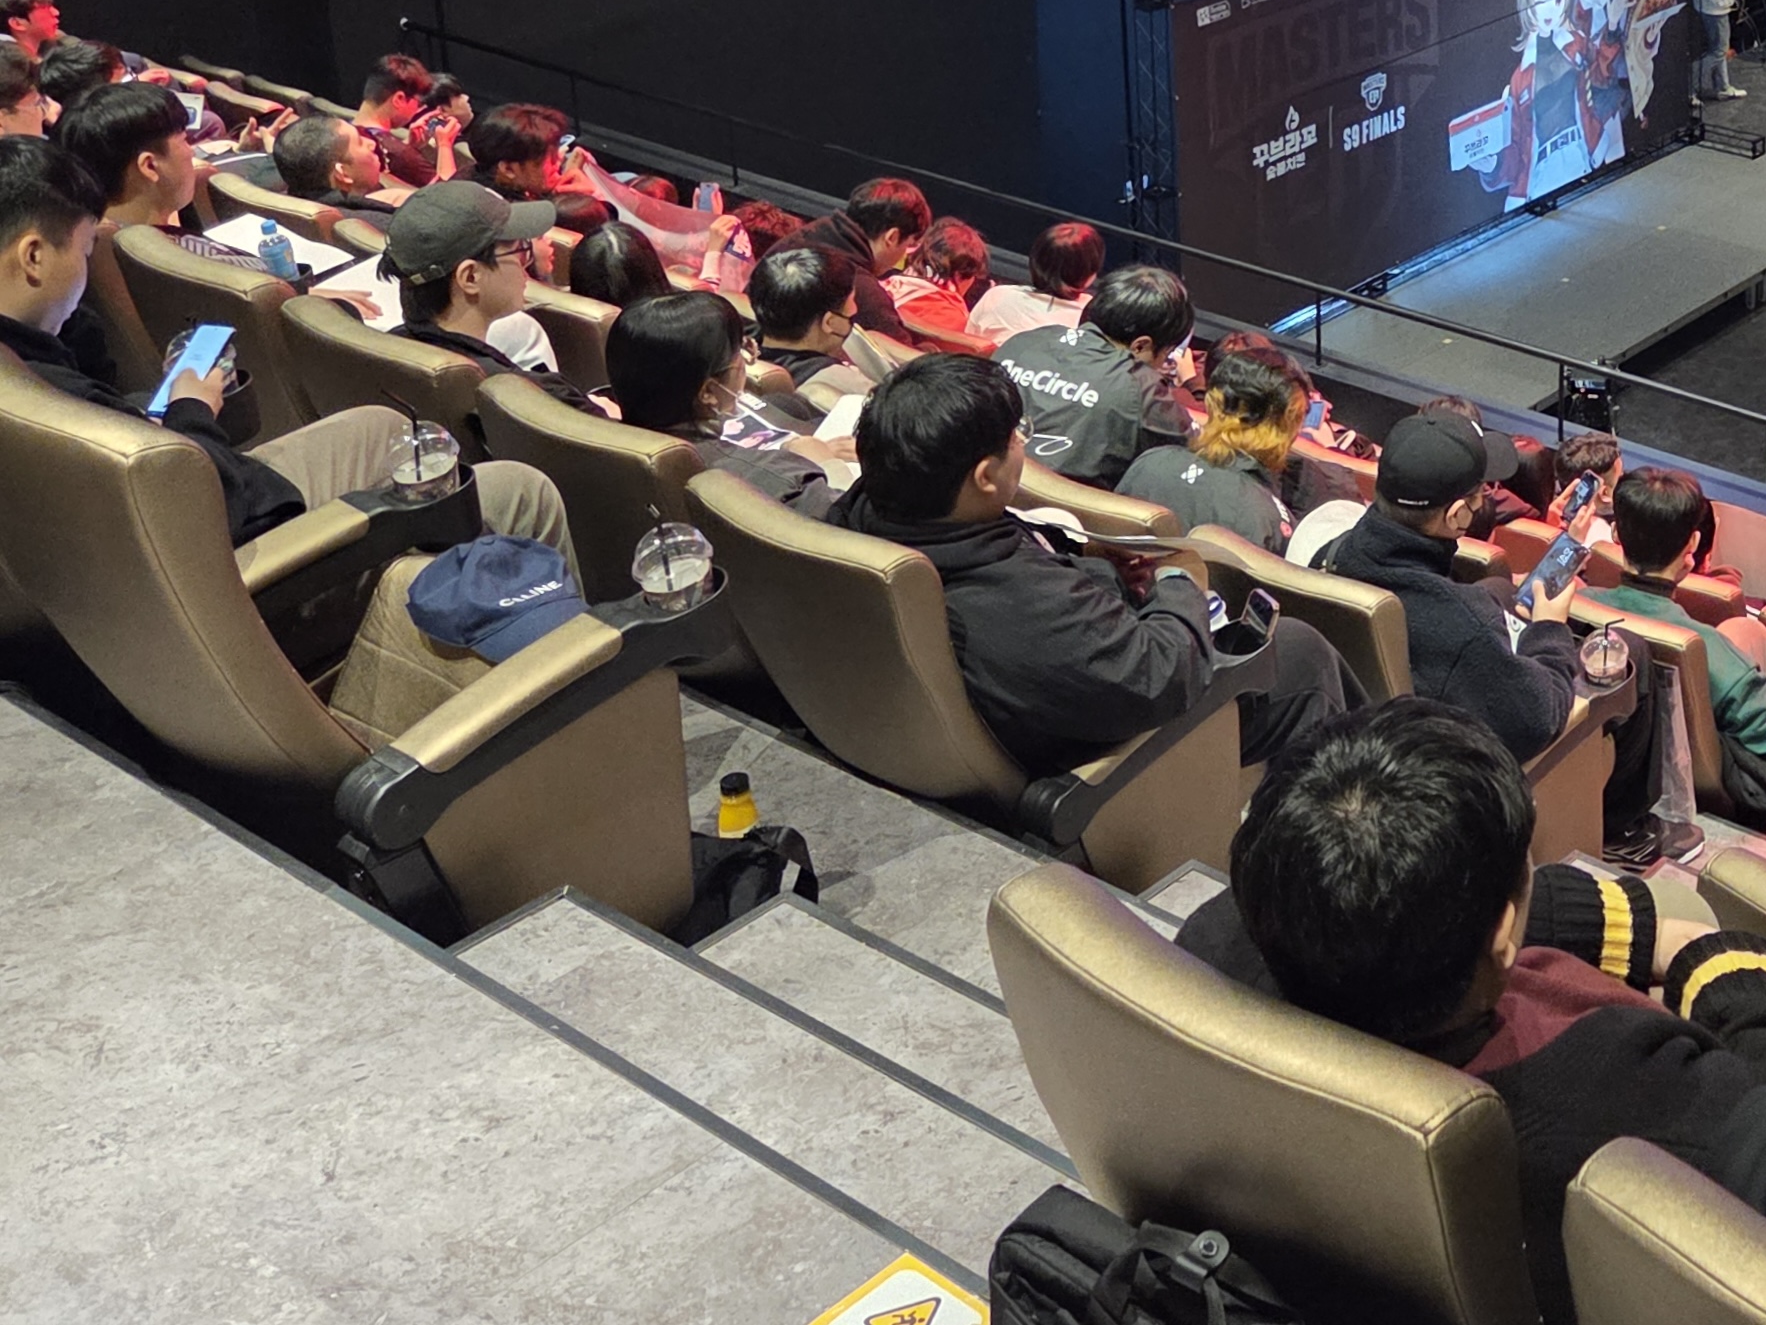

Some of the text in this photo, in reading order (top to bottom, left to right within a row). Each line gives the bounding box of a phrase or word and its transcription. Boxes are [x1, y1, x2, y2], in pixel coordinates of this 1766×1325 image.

[1253, 124, 1318, 168] 꾸브라꼬
[1343, 106, 1406, 152] S9 FINALS
[1266, 152, 1306, 181] 숯불치킨
